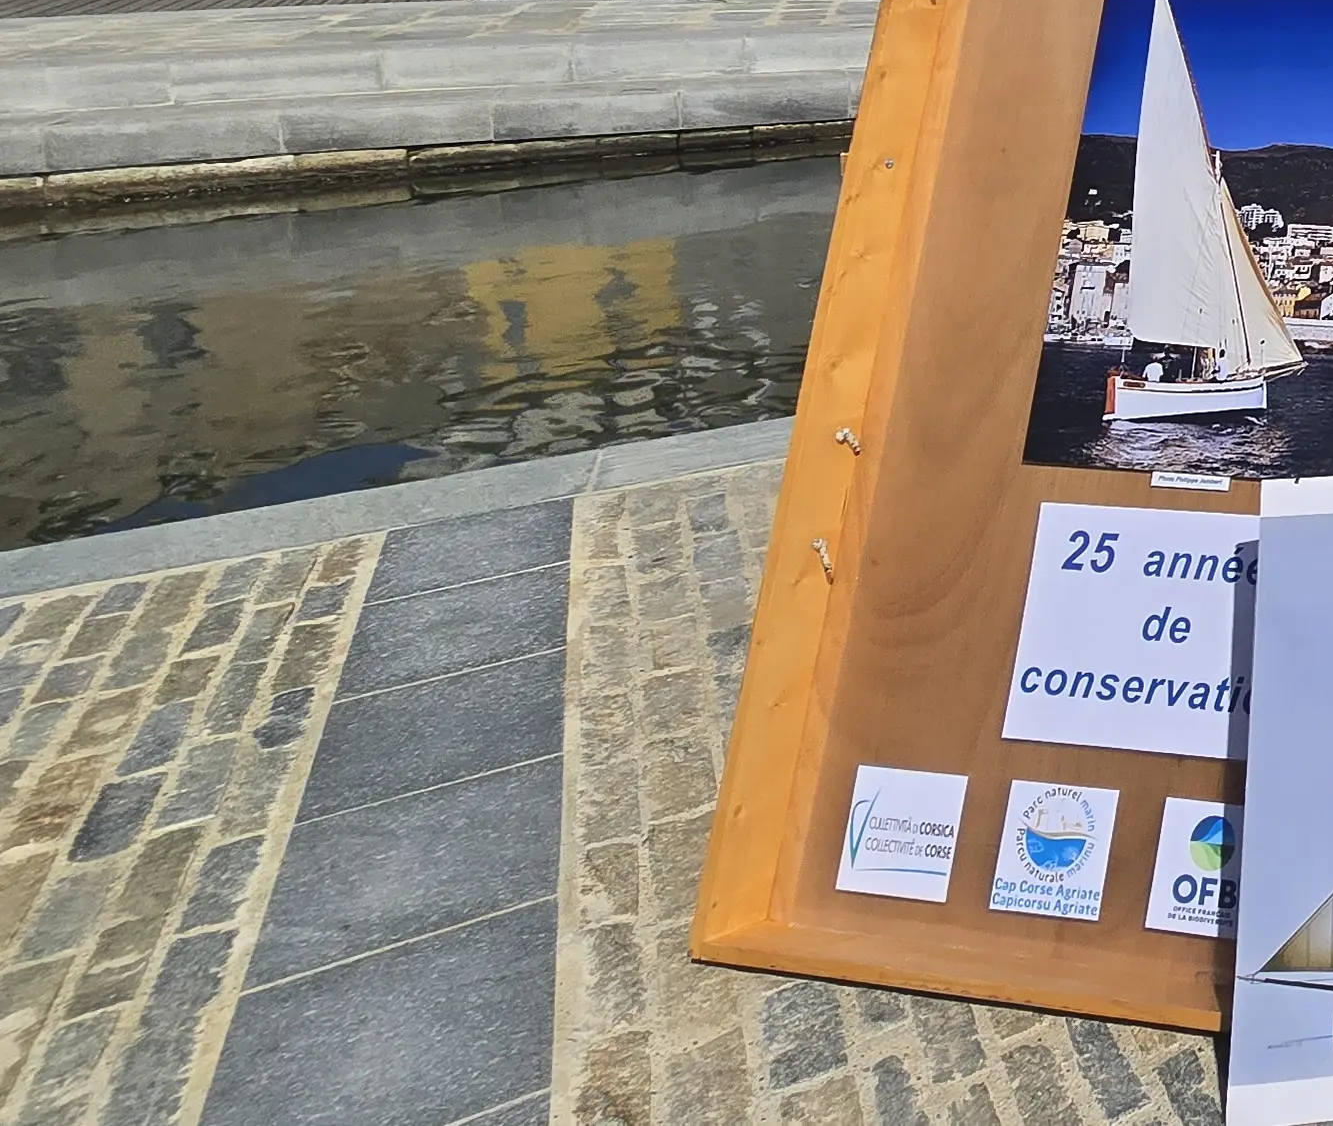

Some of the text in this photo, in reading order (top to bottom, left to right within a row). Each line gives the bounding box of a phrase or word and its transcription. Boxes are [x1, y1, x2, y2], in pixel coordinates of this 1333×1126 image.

[1061, 530, 1120, 573] 25
[1142, 607, 1192, 644] de
[1022, 787, 1096, 832] Parc naturel marin
[919, 821, 955, 838] CORSICA
[864, 837, 915, 856] COLLECTIVITÉ
[924, 843, 952, 859] CORSE
[1016, 828, 1095, 883] Parcu naturale marinu
[992, 892, 1098, 916] Capicorsu Agriate
[995, 877, 1101, 901] Cap Corse Agriate
[1172, 873, 1237, 909] OFB
[1172, 905, 1197, 914] OFFICE
